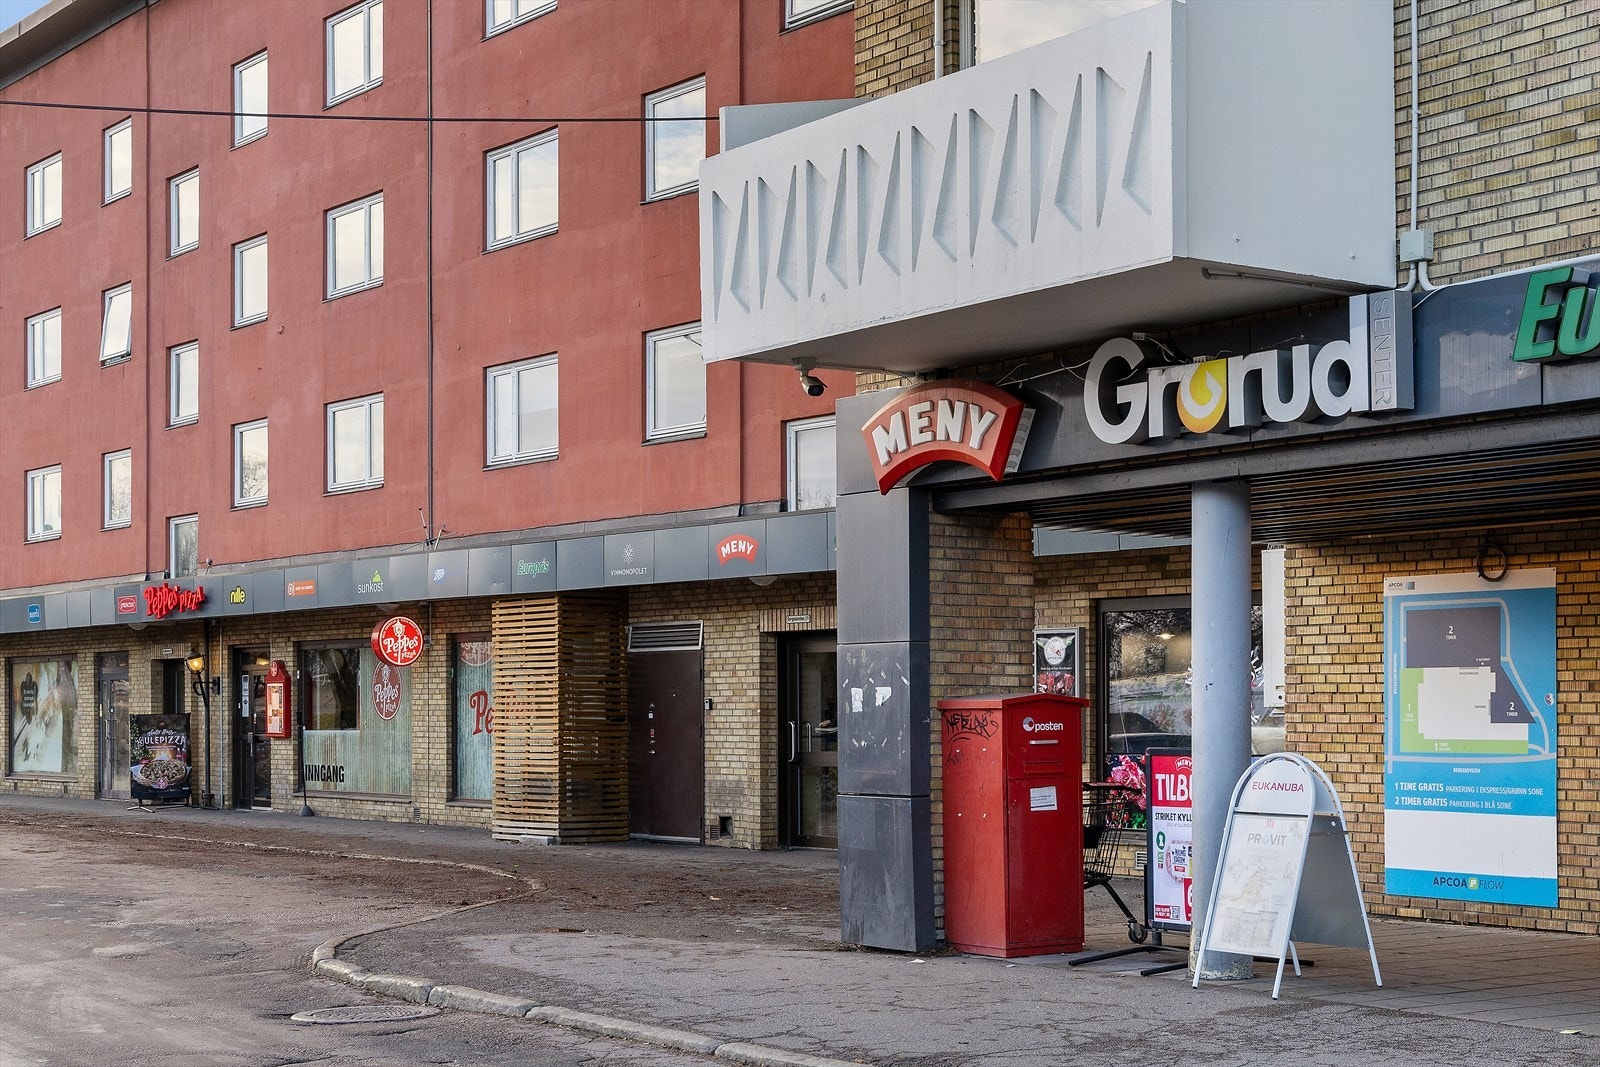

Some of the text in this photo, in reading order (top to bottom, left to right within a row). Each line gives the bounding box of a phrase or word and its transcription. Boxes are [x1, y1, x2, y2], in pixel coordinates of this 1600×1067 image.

[1373, 296, 1392, 405] SENTER
[872, 398, 998, 467] MENY
[720, 539, 754, 557] MENY
[610, 567, 647, 576] VINMONOPOLET
[357, 580, 384, 594] sunkost
[230, 586, 246, 604] nille
[1448, 625, 1454, 634] 2
[383, 635, 419, 653] Peppes
[1509, 702, 1515, 711] 2
[1035, 721, 1063, 732] posten
[305, 764, 345, 783] INNGANG
[1251, 781, 1305, 793] EUKANUBA
[1395, 782, 1399, 790] 1
[1400, 782, 1417, 791] TIME
[1418, 783, 1444, 792] GRATIS
[1446, 786, 1475, 794] PARKERING
[1480, 786, 1527, 795] EKSPRESS/GRØNN
[1528, 788, 1543, 796] SONE
[1395, 797, 1400, 805] 2
[1401, 797, 1422, 806] TIMER
[1423, 798, 1448, 807] GRATIS
[1449, 800, 1480, 809] PARKERING
[1485, 799, 1496, 808] BLÅ
[1497, 801, 1512, 810] SONE
[1433, 876, 1468, 888] APCOA
[1479, 880, 1504, 890] FLOW
